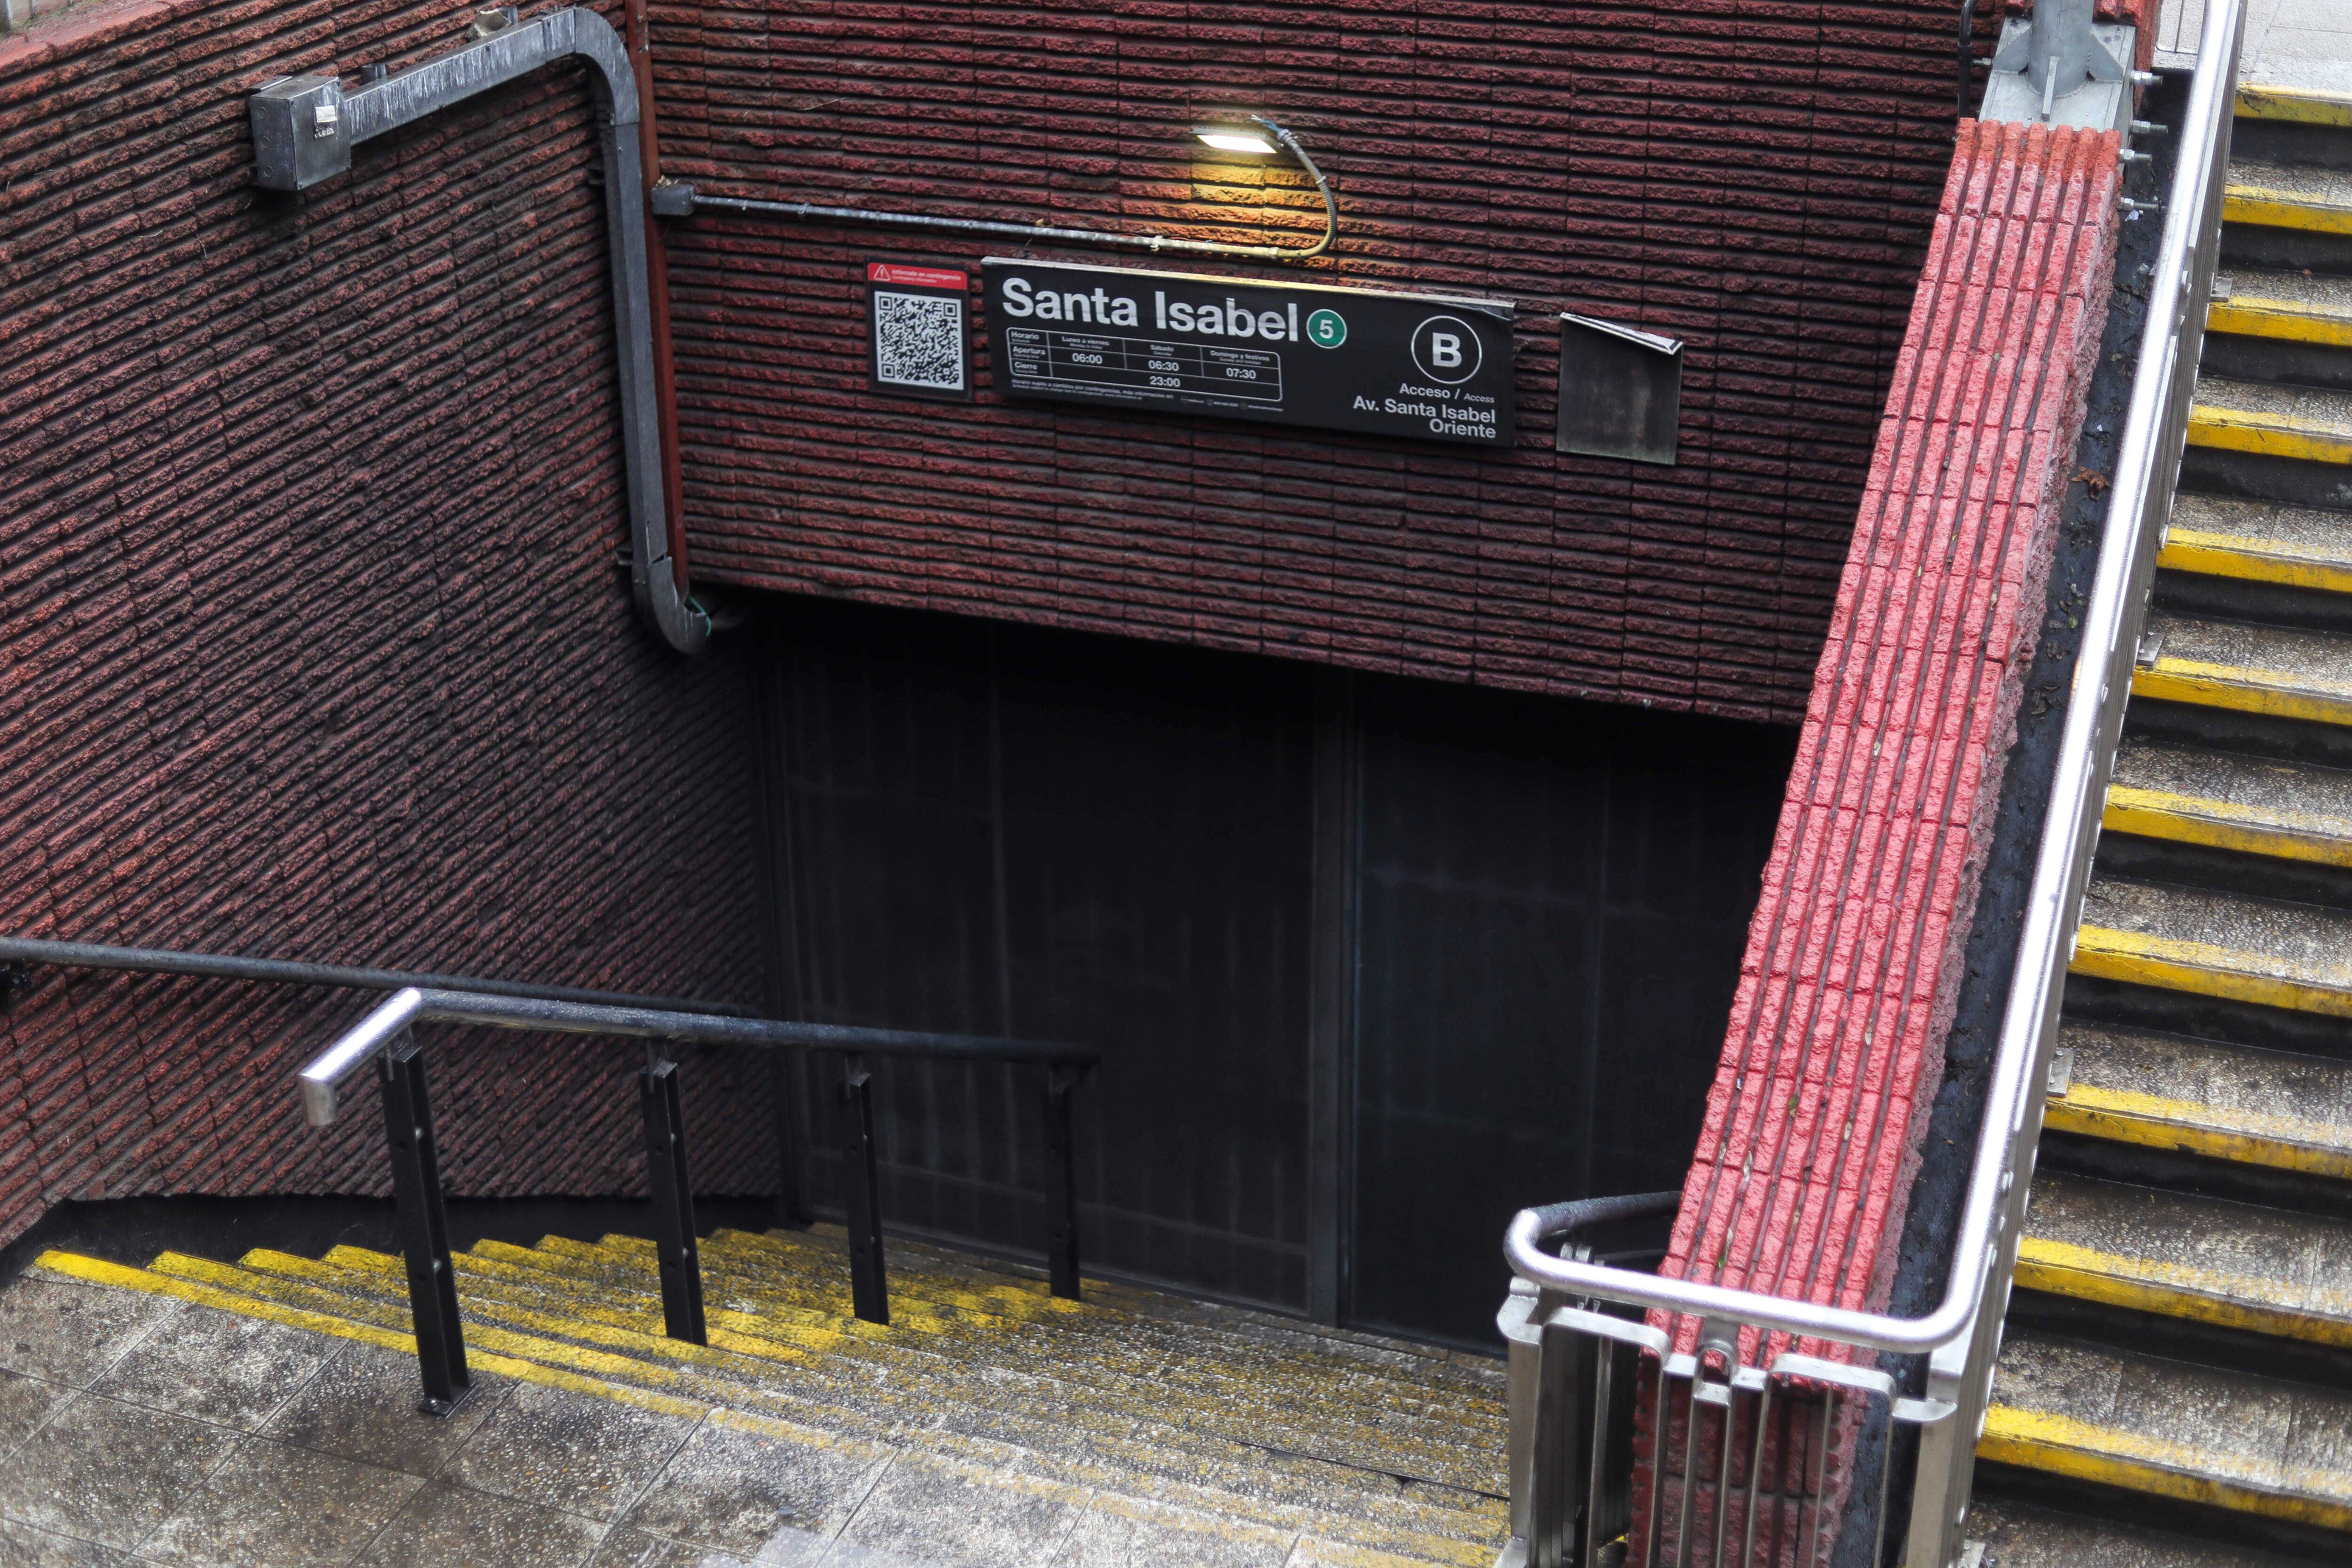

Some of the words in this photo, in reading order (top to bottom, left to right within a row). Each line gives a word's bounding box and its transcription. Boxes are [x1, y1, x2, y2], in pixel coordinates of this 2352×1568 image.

[1002, 277, 1138, 326] Santa
[1155, 291, 1298, 342] Isabel
[1319, 319, 1334, 339] 5
[1011, 331, 1039, 340] Horario
[1012, 345, 1046, 355] Apertura
[1432, 332, 1462, 367] B
[1072, 353, 1103, 364] 06:00
[1210, 350, 1238, 359] Domingo
[1245, 353, 1270, 362] festivos
[1014, 361, 1038, 370] Cierre
[1148, 360, 1179, 372] 06:30
[1226, 367, 1256, 380] 07:30
[1150, 376, 1181, 388] 23:00
[1399, 383, 1450, 399] Acceso
[1454, 389, 1460, 399] /
[1463, 393, 1495, 404] Access
[1353, 395, 1379, 411] Av.
[1385, 398, 1436, 417] Santa
[1442, 404, 1496, 423] Isabel
[1430, 418, 1496, 438] Oriente
